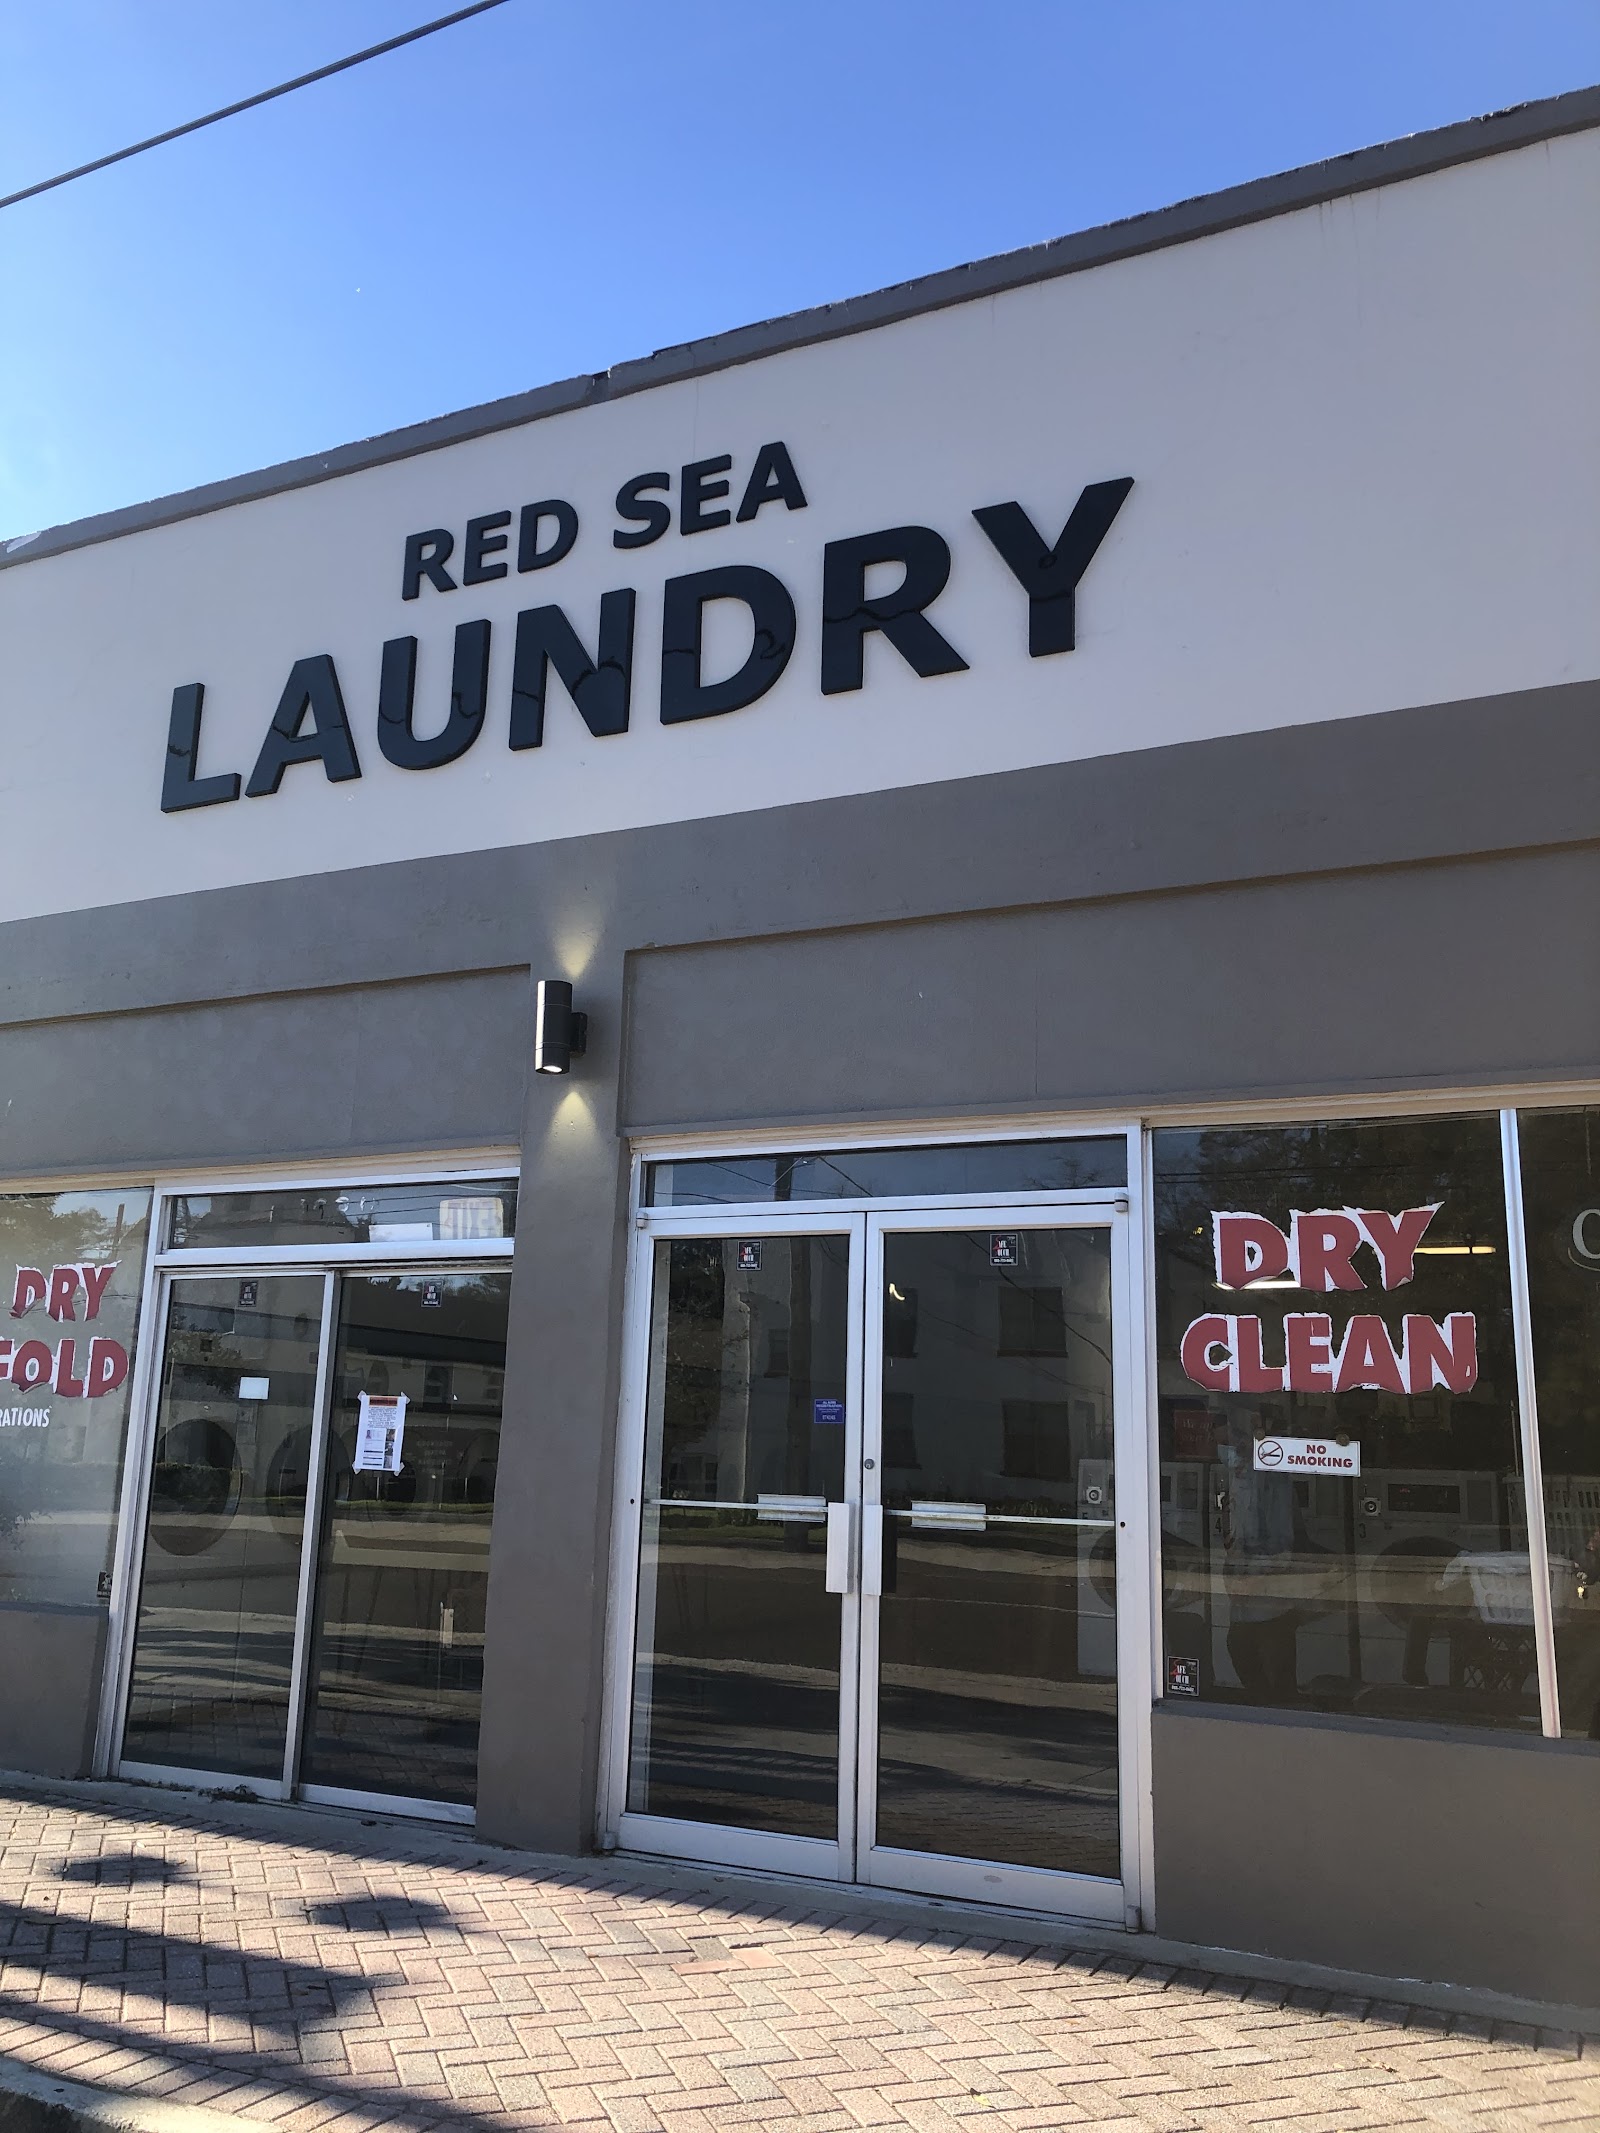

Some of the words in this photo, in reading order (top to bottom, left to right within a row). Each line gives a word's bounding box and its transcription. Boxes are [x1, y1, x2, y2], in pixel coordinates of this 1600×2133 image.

[401, 499, 579, 601] RED
[613, 441, 808, 549] SEA
[161, 476, 1134, 814] LAUNDRY
[1211, 1202, 1444, 1291] DRY
[9, 1261, 121, 1322] DRY
[1180, 1312, 1478, 1394] CLEAN
[1287, 1455, 1353, 1468] SMOKING
[1306, 1445, 1327, 1455] NO
